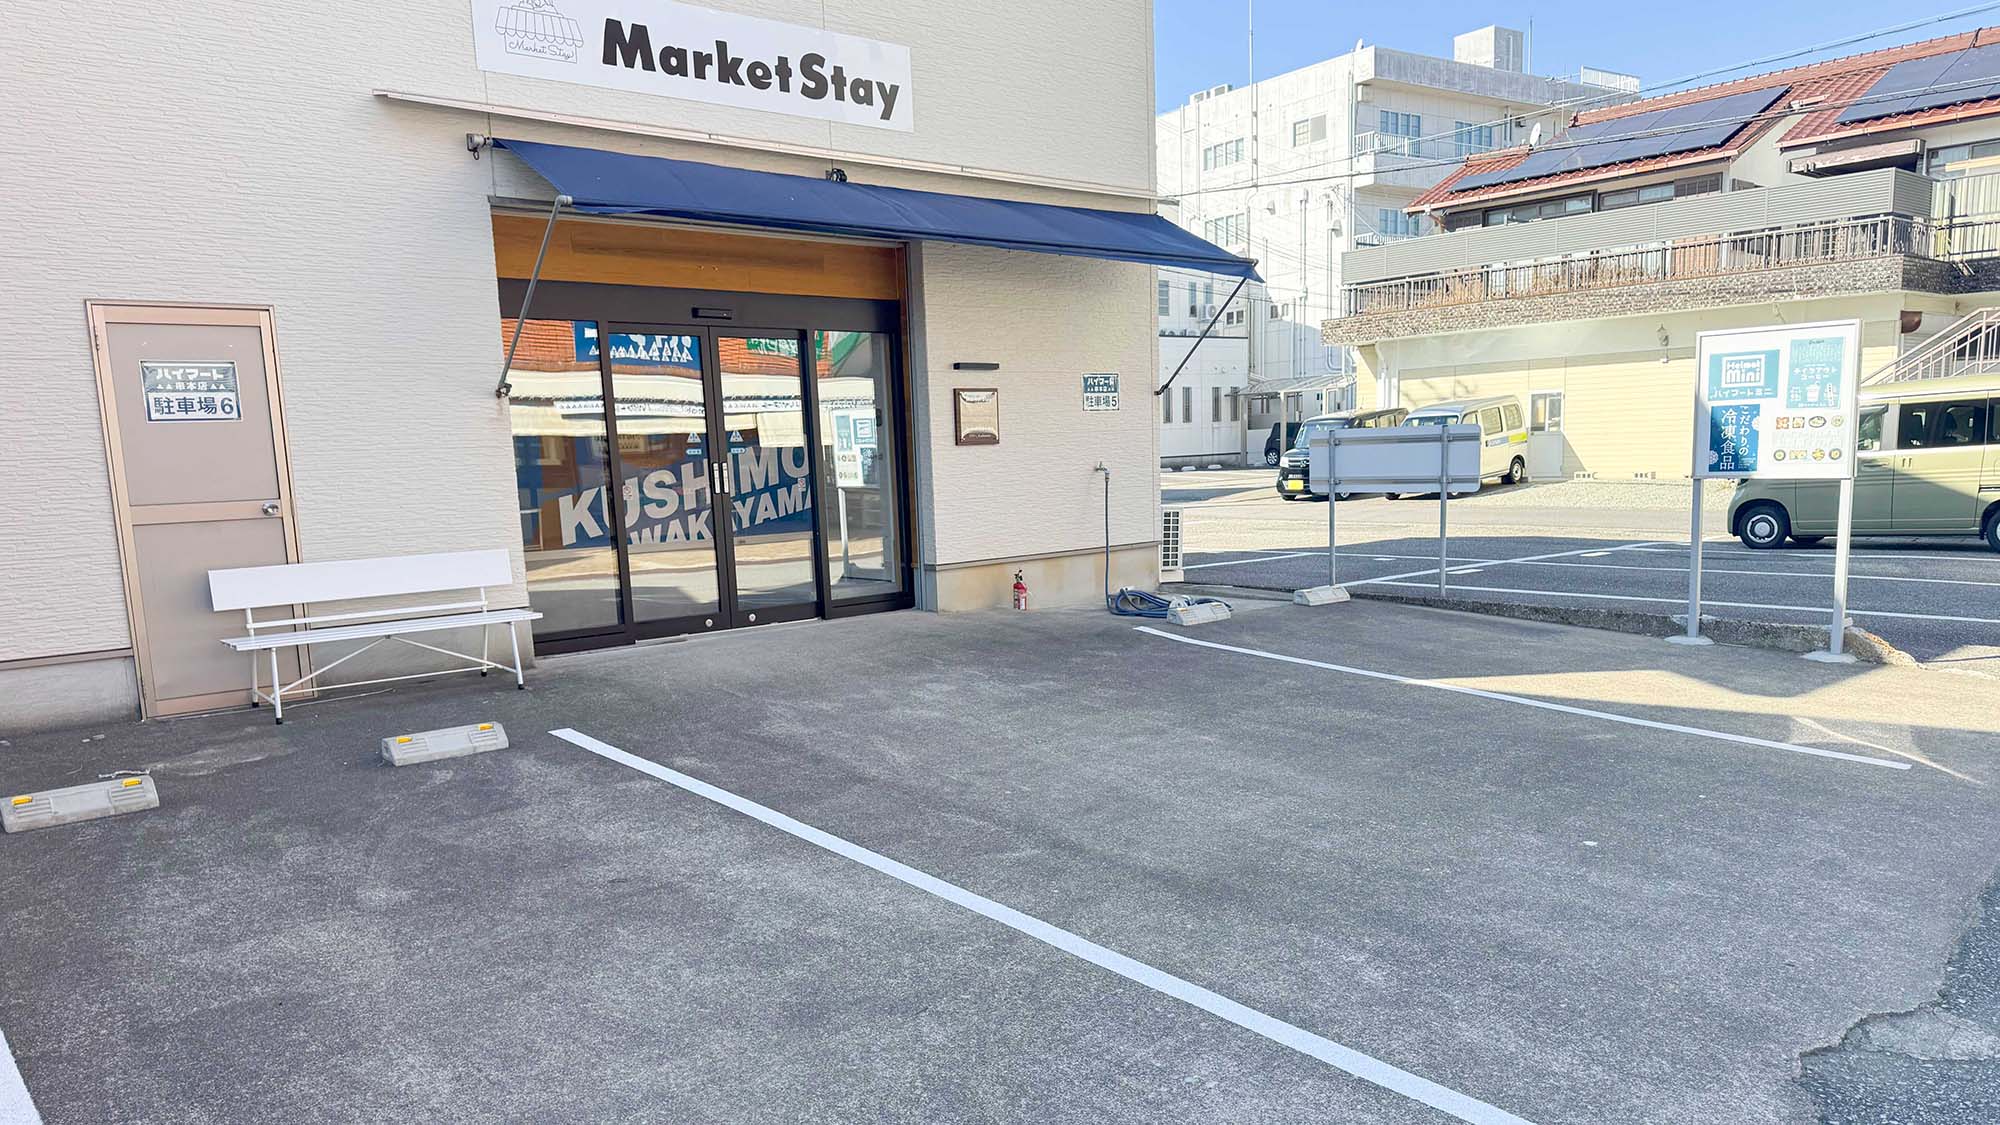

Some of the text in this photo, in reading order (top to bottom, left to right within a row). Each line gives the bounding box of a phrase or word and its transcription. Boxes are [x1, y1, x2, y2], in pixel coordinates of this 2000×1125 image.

[509, 40, 574, 60] Market Stay
[156, 368, 224, 380] ハイマート
[1726, 369, 1760, 383] Mini
[154, 396, 234, 415] 駐車場6
[1720, 408, 1738, 470] 冷凍食品
[1739, 405, 1751, 456] こだわりの
